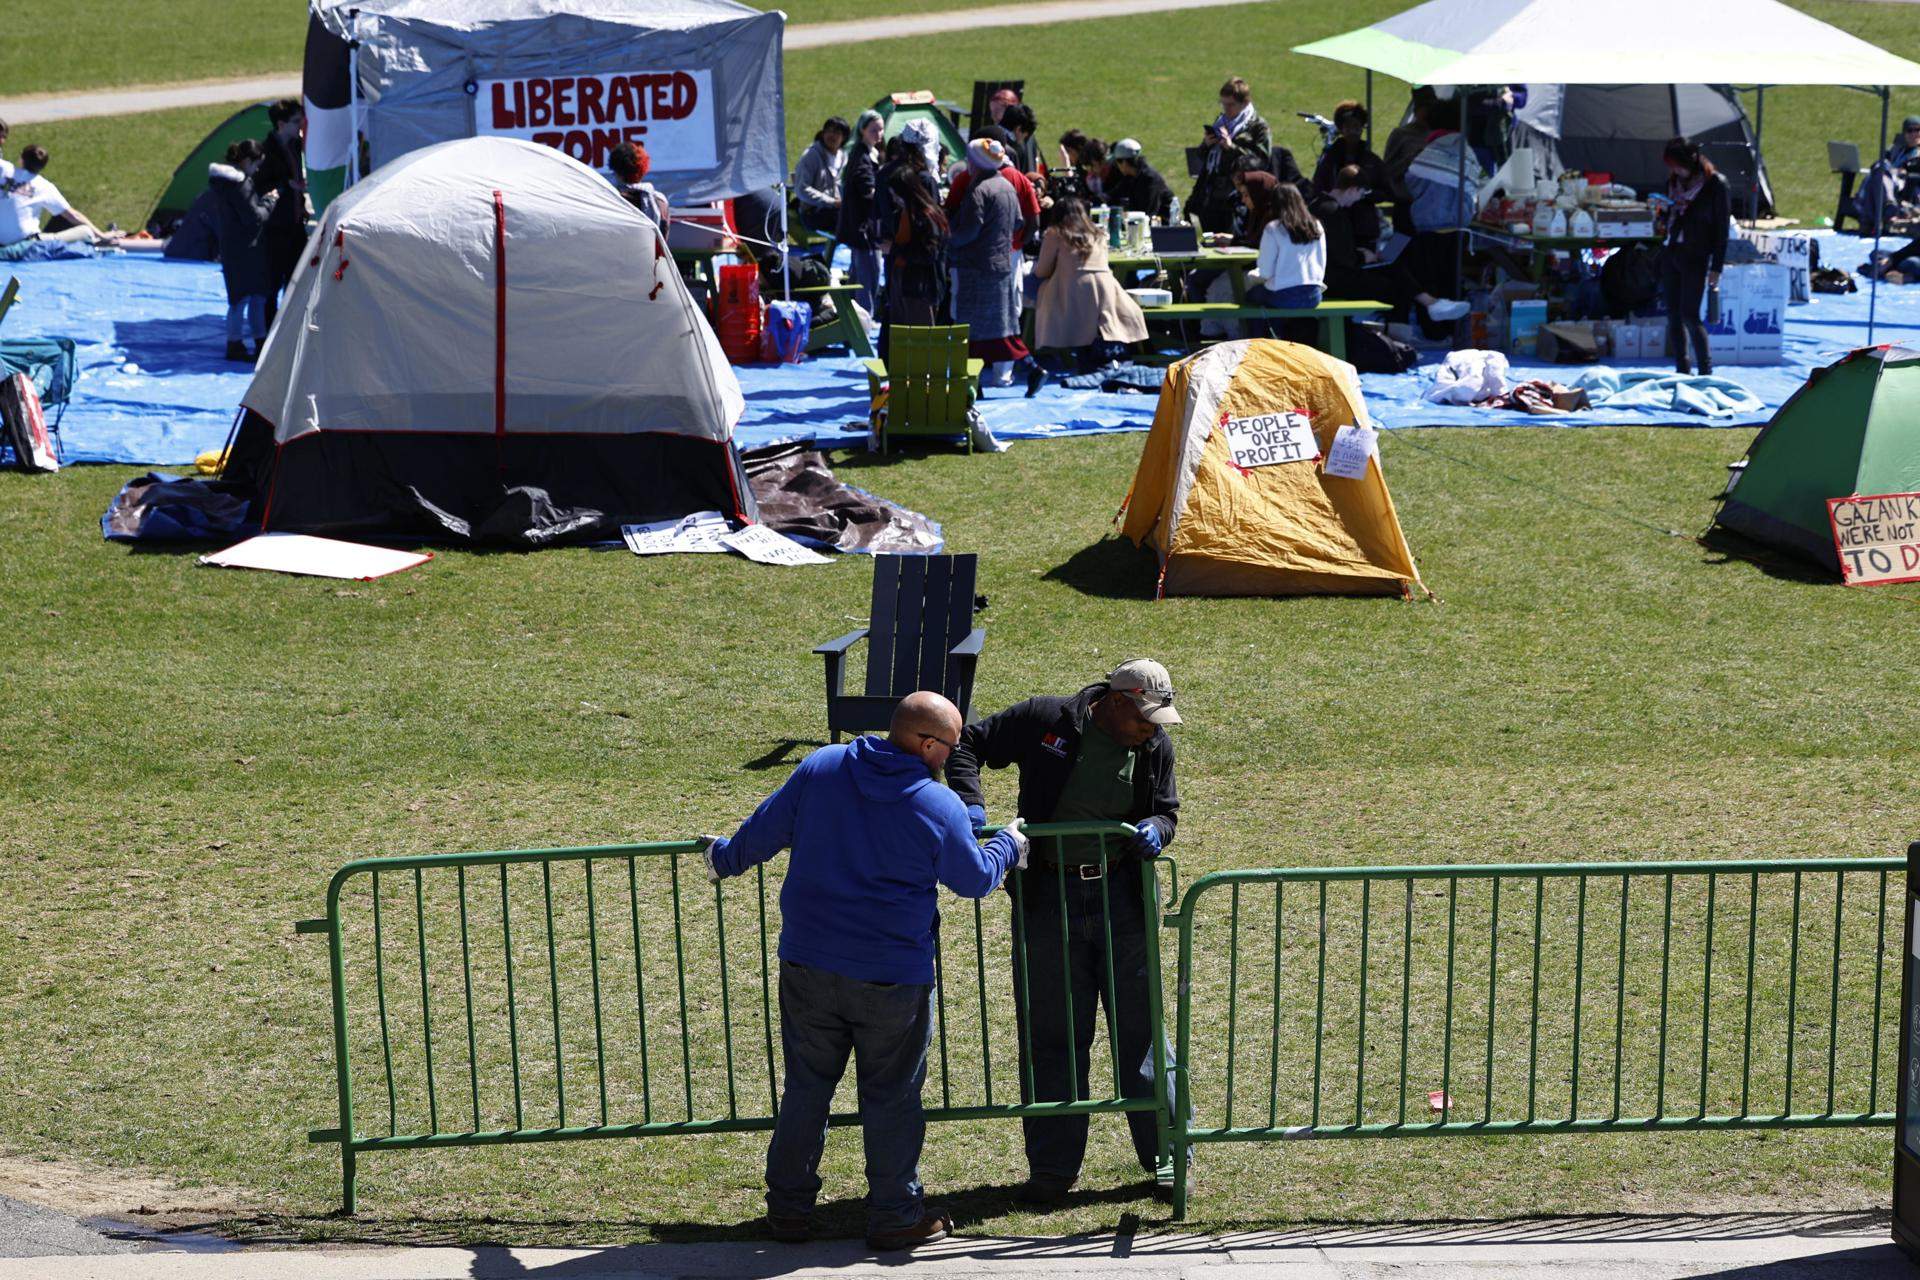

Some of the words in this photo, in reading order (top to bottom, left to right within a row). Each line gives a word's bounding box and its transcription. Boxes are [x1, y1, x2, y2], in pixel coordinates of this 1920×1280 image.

[491, 71, 698, 129] LIBERATED
[1227, 413, 1300, 436] PEOPLE
[1251, 430, 1293, 446] OVER
[1234, 442, 1301, 465] PROFIT
[1840, 524, 1884, 546] WERE
[1887, 523, 1914, 541] NOT
[1844, 548, 1892, 577] TO
